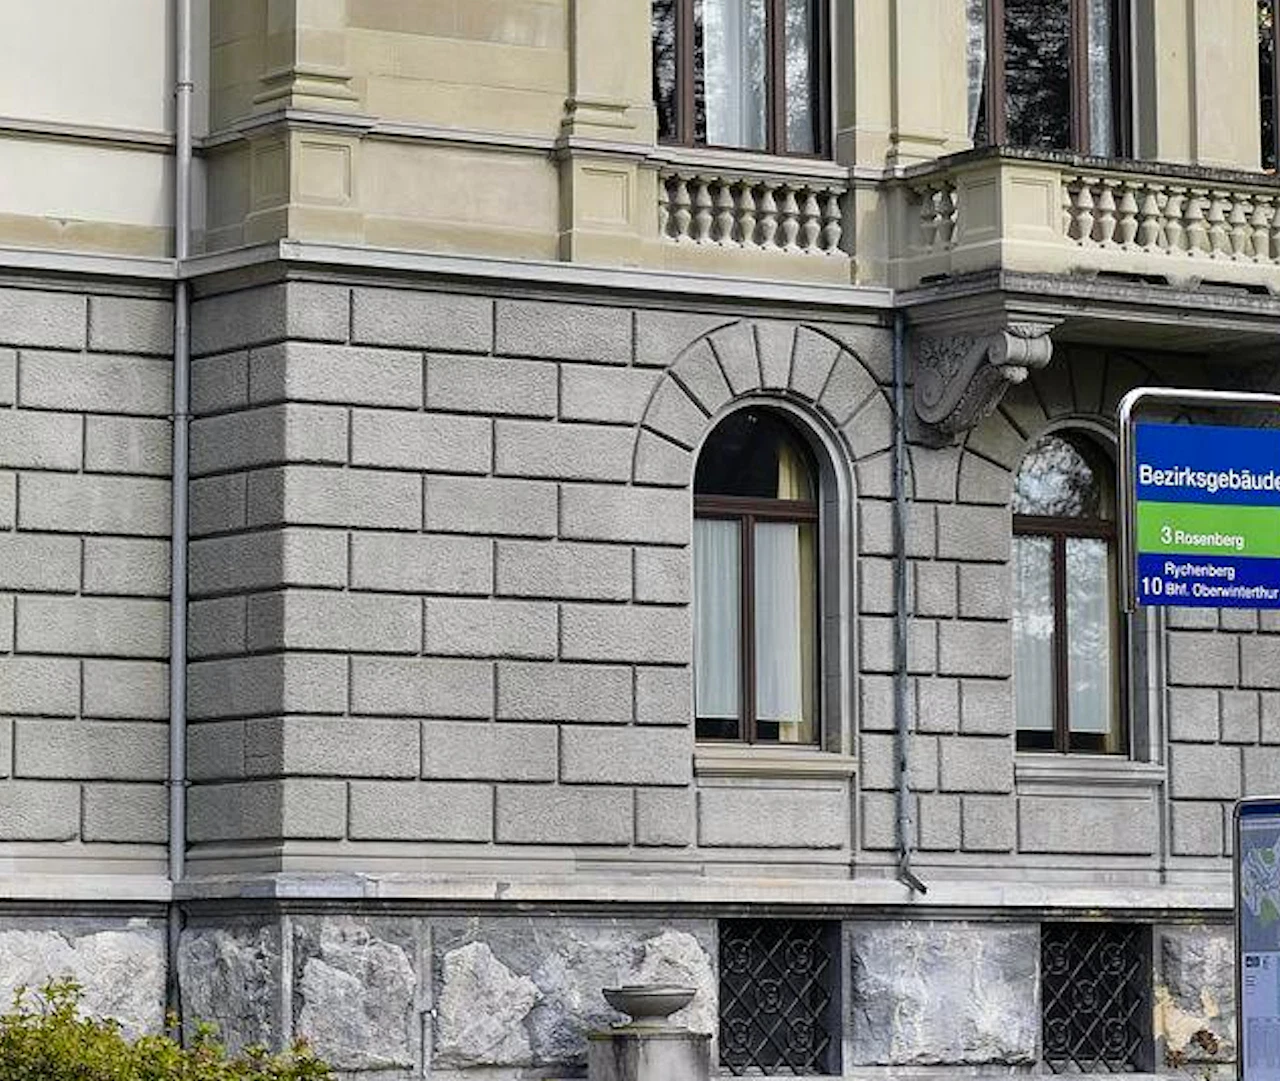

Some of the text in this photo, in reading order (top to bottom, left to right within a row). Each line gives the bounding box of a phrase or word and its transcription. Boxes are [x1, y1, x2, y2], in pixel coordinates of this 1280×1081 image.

[1161, 526, 1245, 550] 3 Rosenberg
[1164, 561, 1236, 580] Rychenberg
[1141, 577, 1280, 599] 10 Bhf. Oberwinterthur
